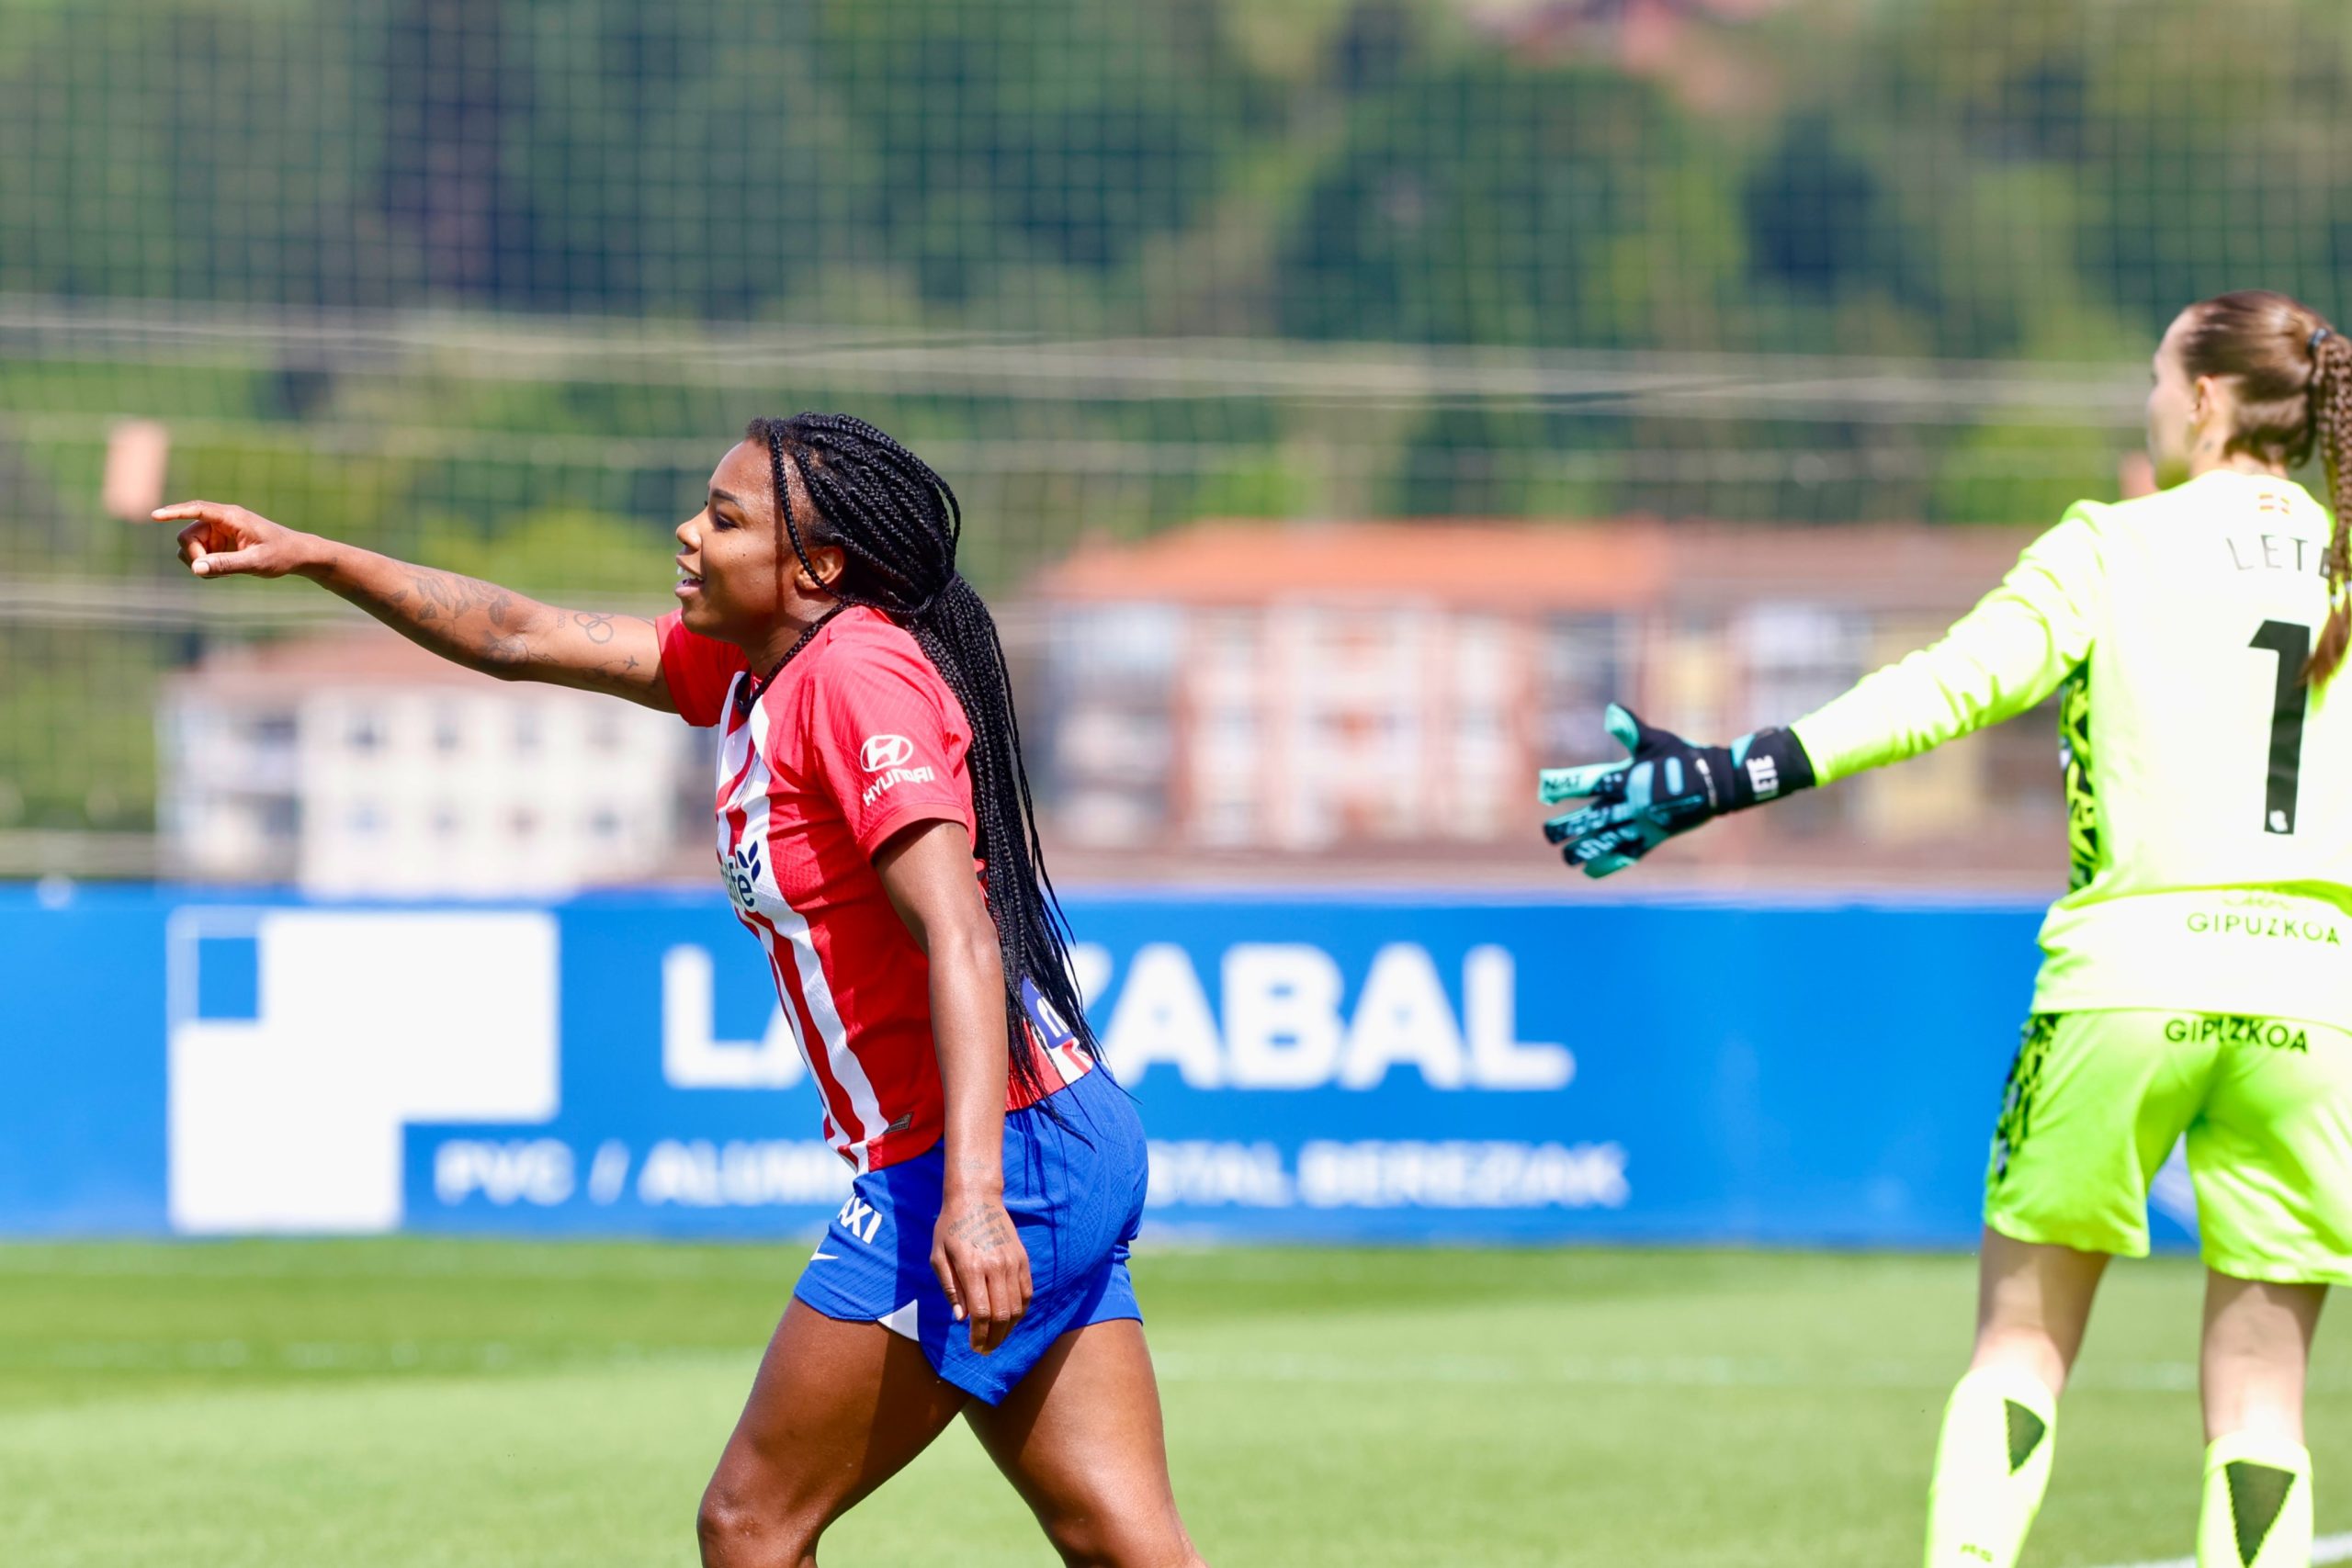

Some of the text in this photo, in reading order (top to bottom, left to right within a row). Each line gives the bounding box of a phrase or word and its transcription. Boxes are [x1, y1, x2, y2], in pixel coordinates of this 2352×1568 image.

[2248, 619, 2311, 836] 1
[863, 766, 935, 807] HYUNDAI
[2187, 912, 2341, 946] GIPUZKOA
[435, 1138, 575, 1205] PVC
[1298, 1138, 1630, 1208] BEREZIAK
